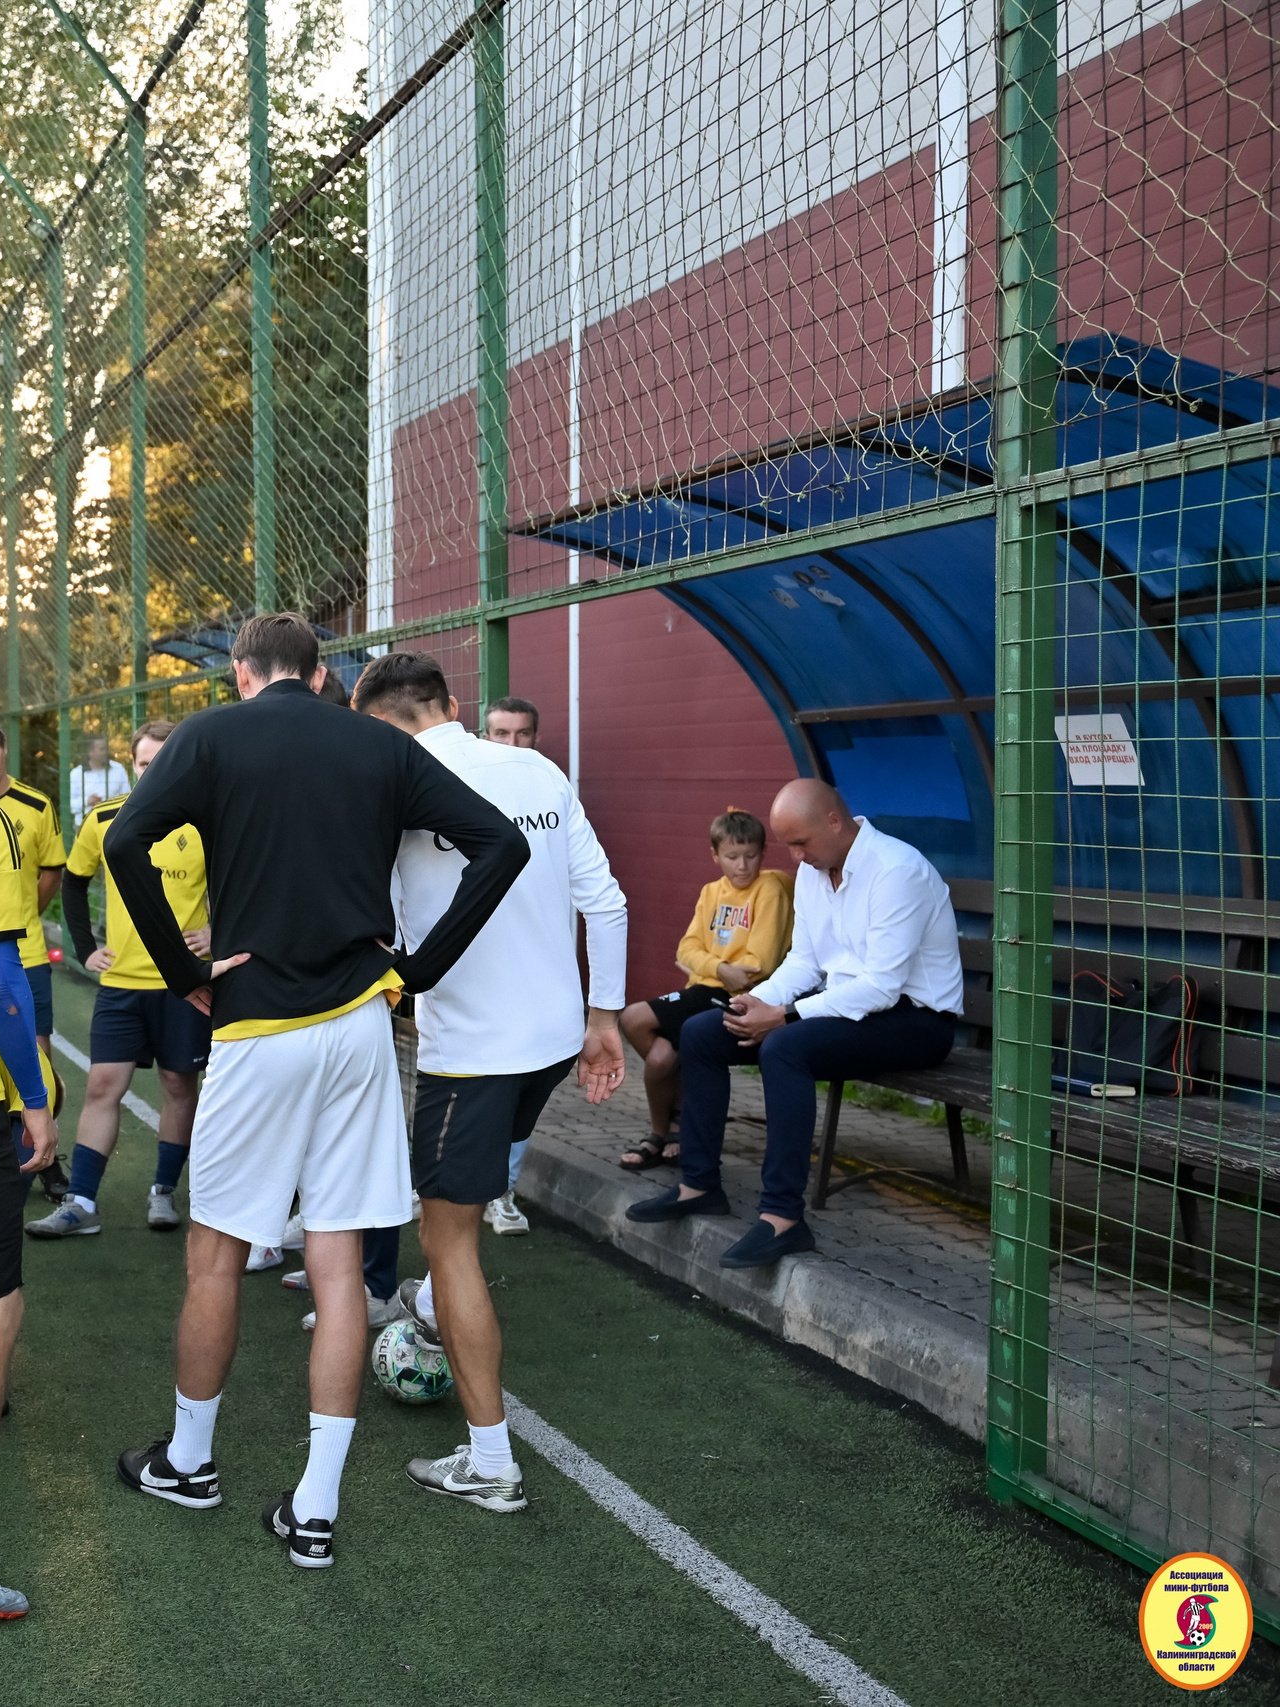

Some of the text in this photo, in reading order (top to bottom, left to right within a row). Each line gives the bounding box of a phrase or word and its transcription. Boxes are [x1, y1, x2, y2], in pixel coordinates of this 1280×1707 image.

[1070, 744, 1126, 753] НА ПЛОЩАДКУ
[1069, 755, 1135, 764] ВХОД ЗАПРЕЩЕН
[161, 869, 187, 880] МО
[378, 1331, 393, 1378] SELECT
[309, 1544, 327, 1553] NIKE
